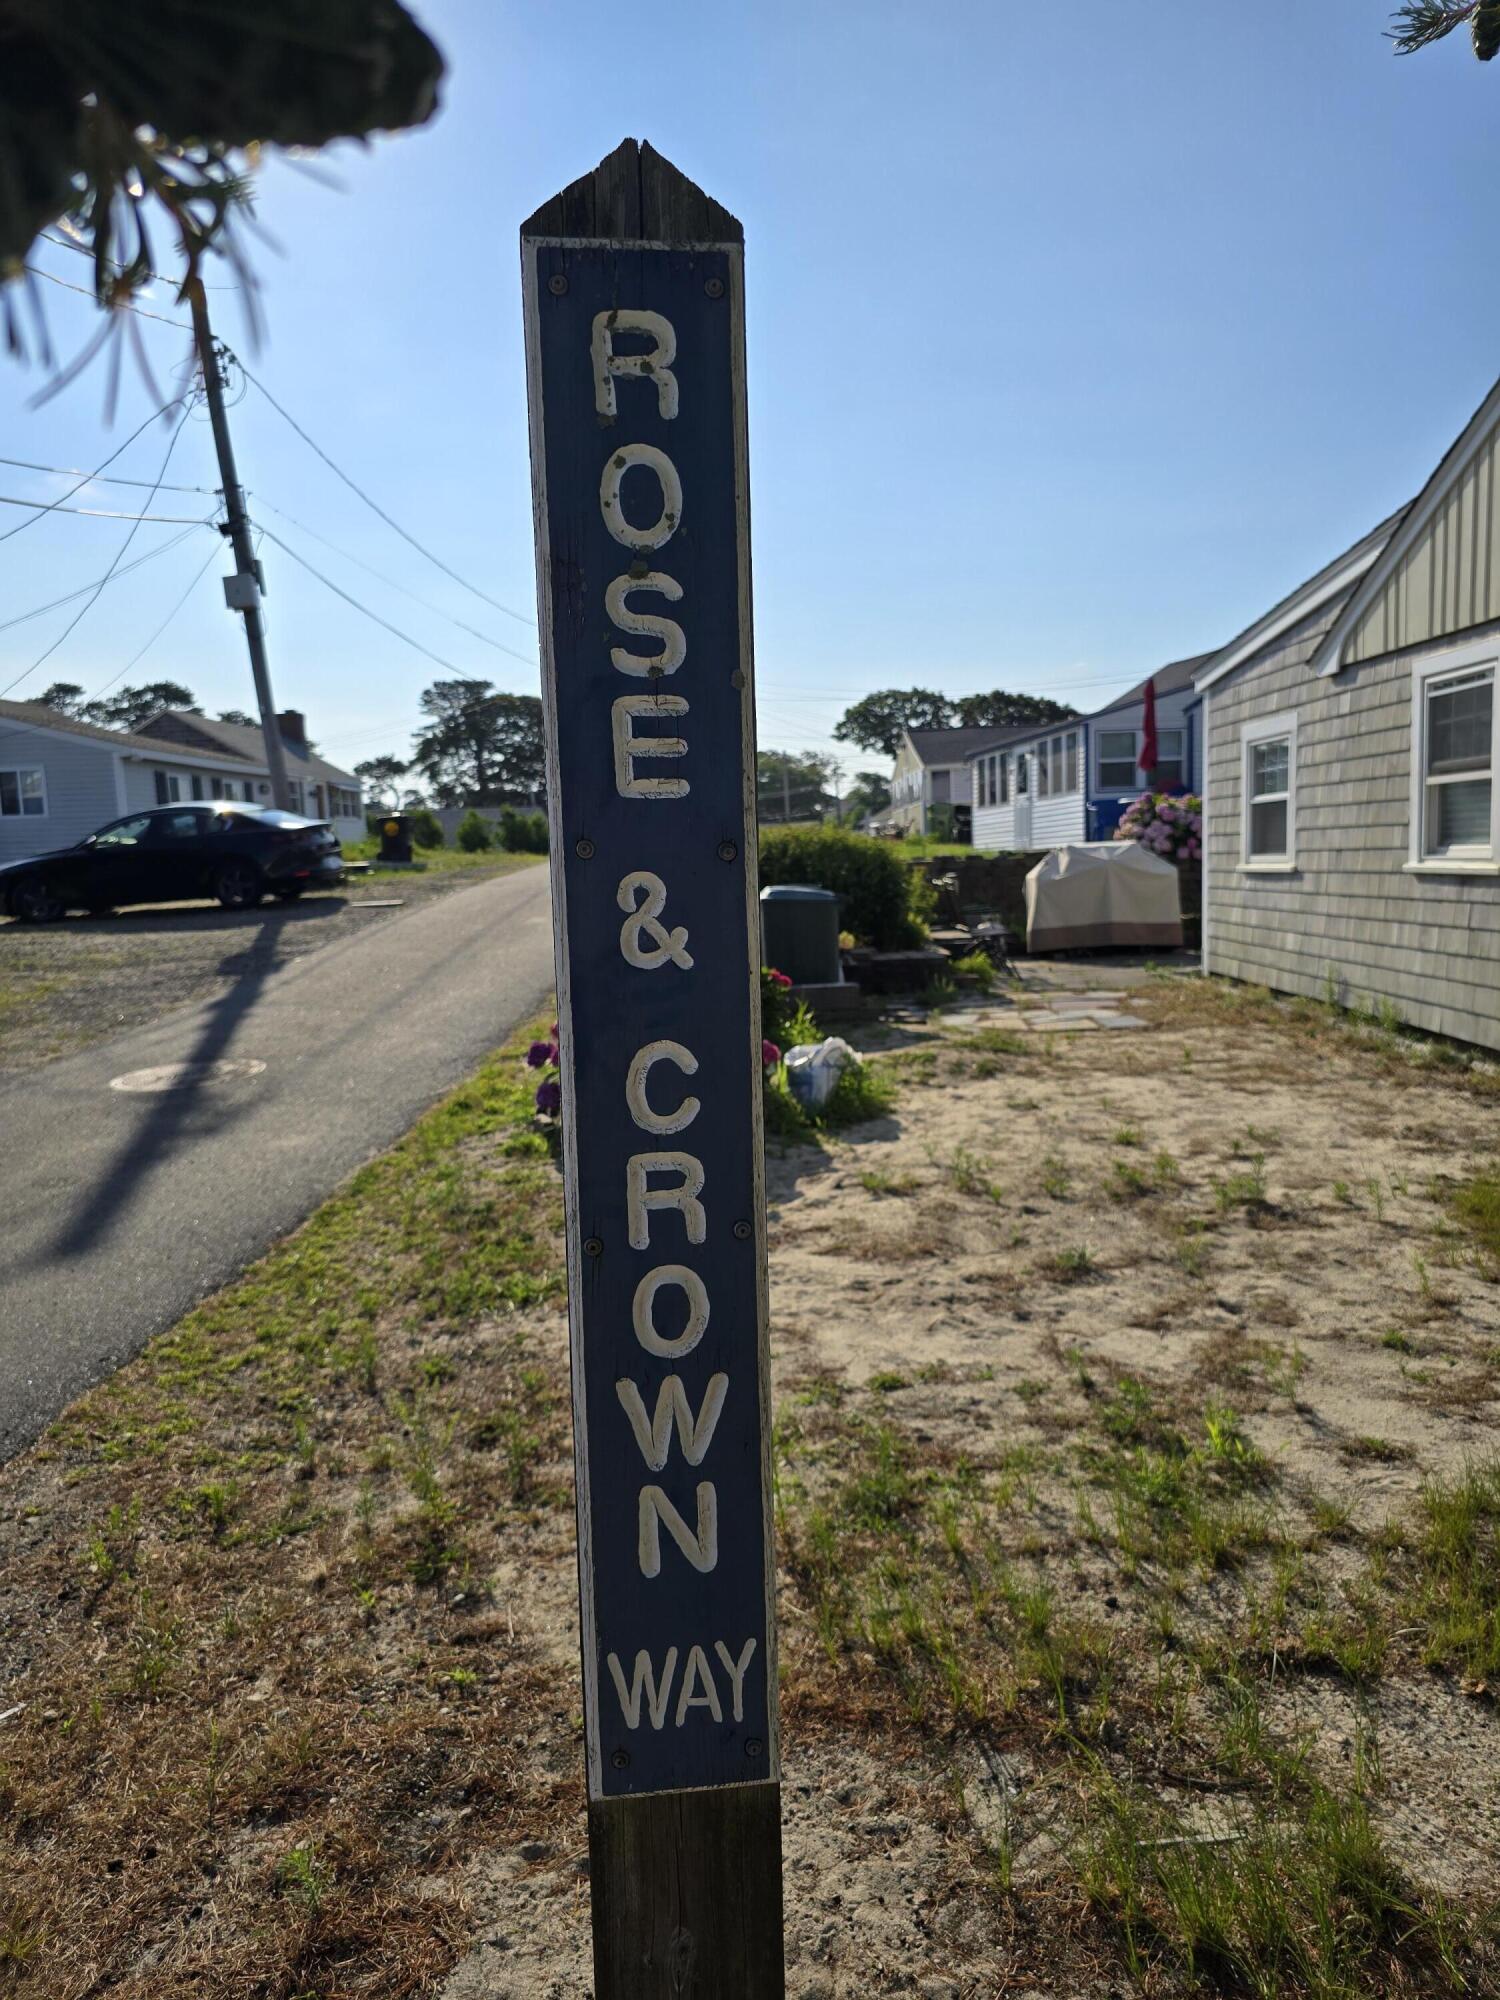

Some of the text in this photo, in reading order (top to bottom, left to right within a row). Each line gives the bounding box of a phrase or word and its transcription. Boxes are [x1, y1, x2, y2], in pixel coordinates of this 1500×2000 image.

[590, 309, 690, 799] ROSE
[617, 871, 694, 970] &
[616, 1039, 729, 1578] CROWN
[607, 1638, 757, 1730] WAY
